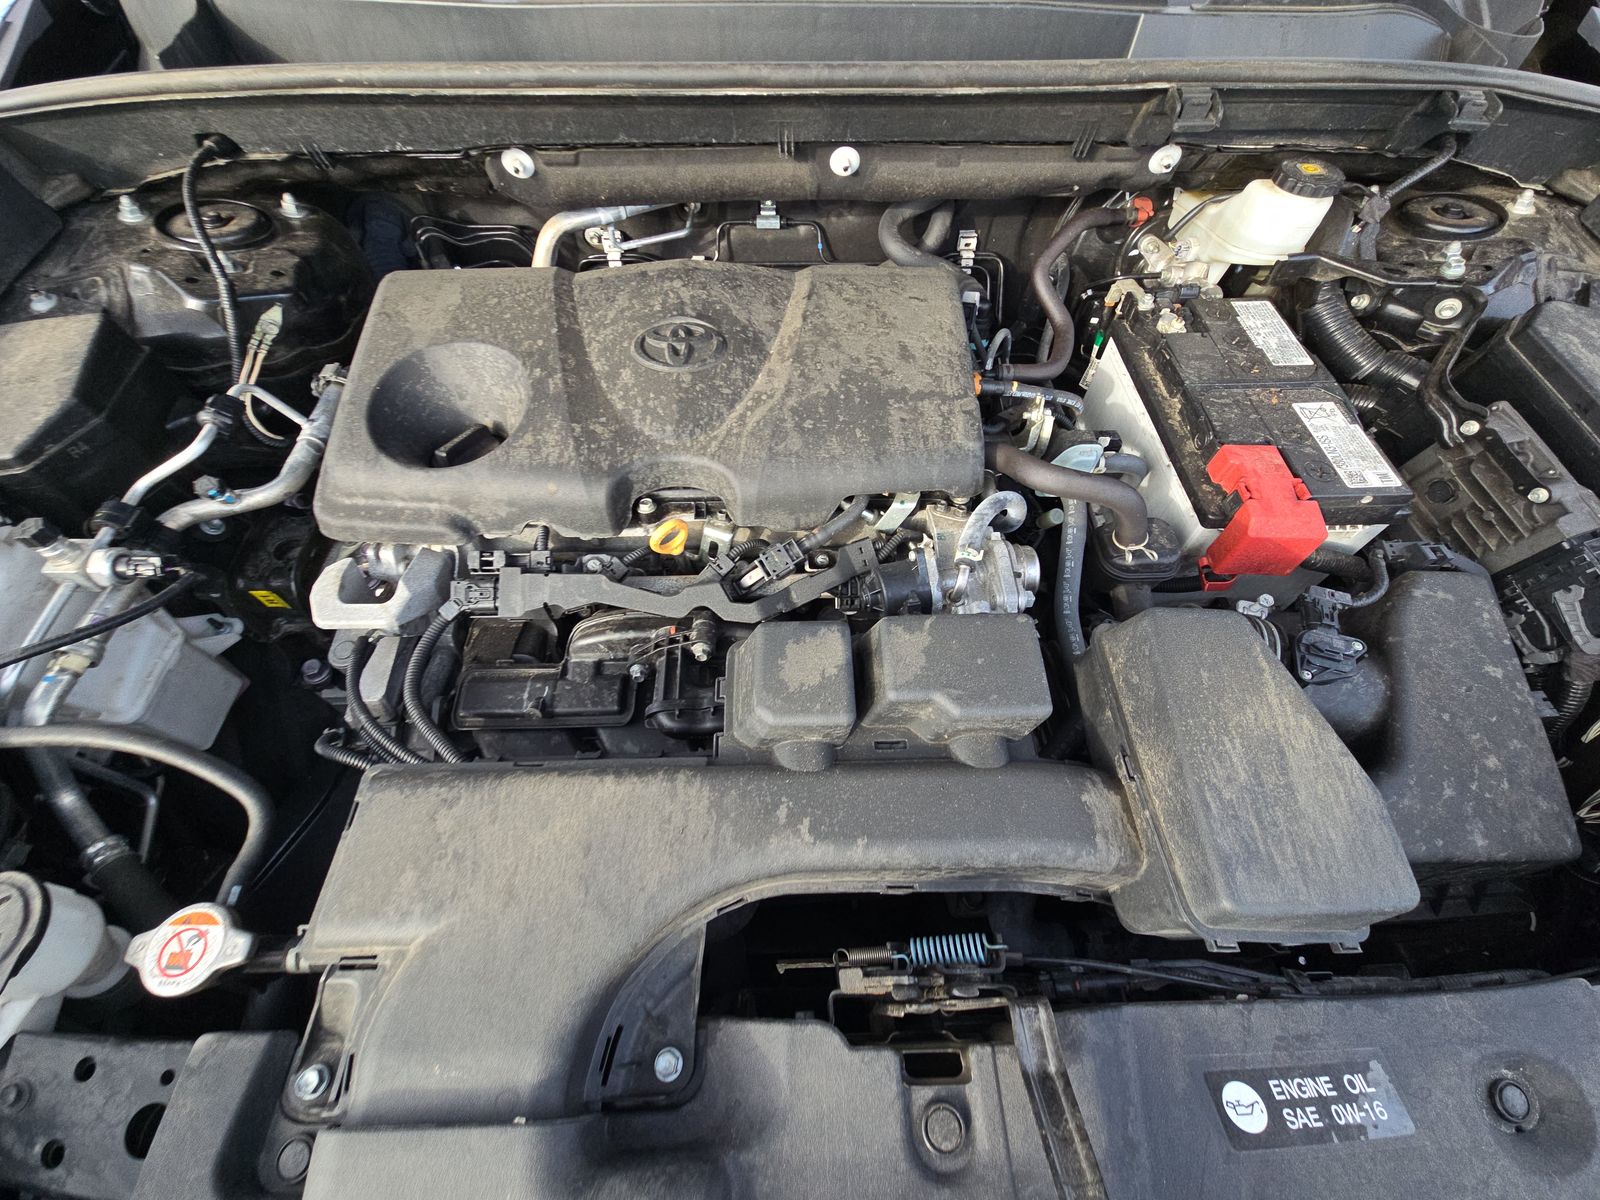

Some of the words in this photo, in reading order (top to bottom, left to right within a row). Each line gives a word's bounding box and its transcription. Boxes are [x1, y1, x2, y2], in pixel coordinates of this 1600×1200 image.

[1268, 1076, 1338, 1101] ENGINE
[1343, 1073, 1376, 1095] OIL
[1282, 1106, 1324, 1130] SAE
[1330, 1101, 1389, 1126] 0W-16
